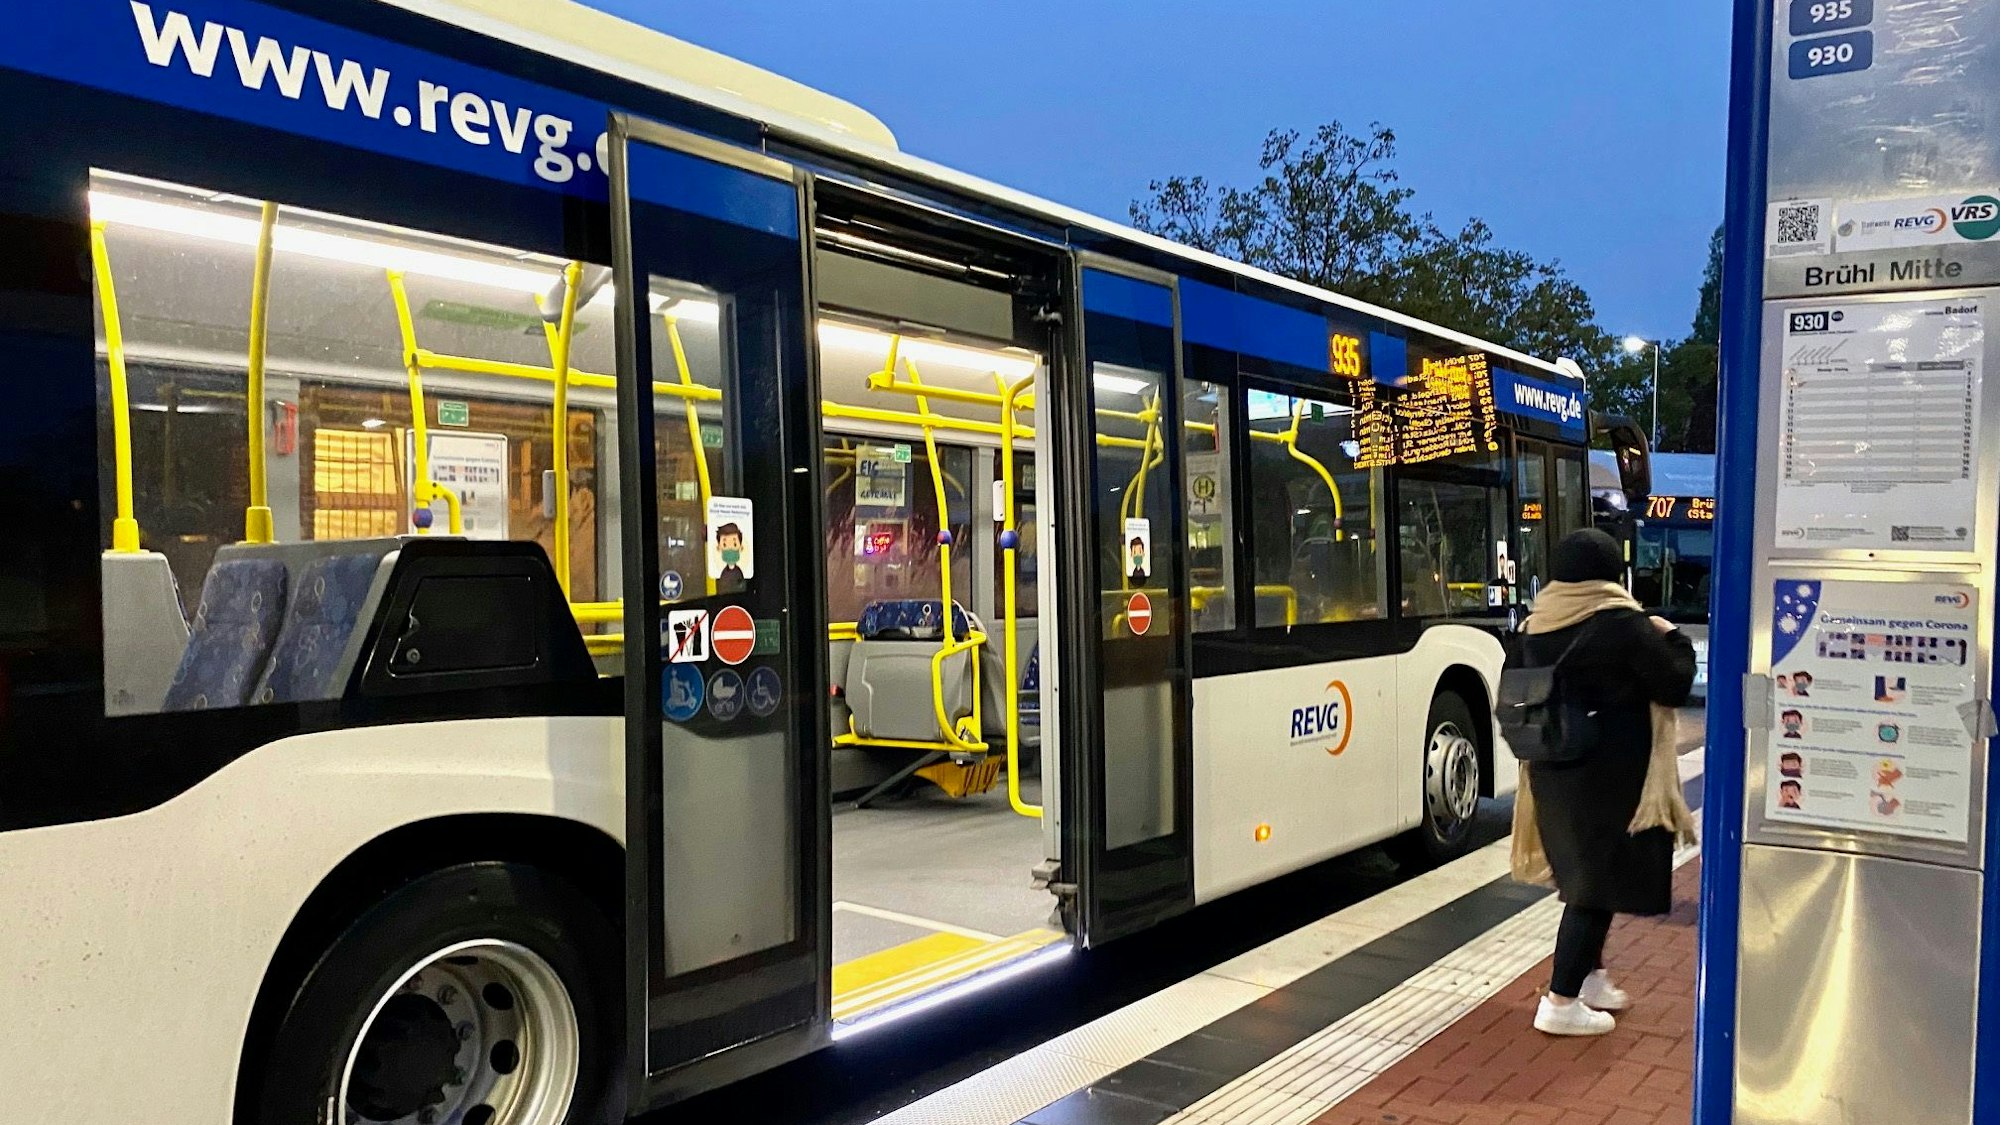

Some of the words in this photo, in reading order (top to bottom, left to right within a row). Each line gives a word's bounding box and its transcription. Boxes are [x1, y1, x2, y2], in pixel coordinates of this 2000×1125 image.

[1810, 0, 1852, 23] 935
[1808, 43, 1853, 67] 930
[1894, 215, 1936, 229] REVG
[1951, 204, 1993, 220] VRS
[1806, 263, 1875, 286] Brühl
[1890, 258, 1962, 281] Mitte
[1794, 314, 1824, 330] 930
[1332, 334, 1360, 376] 935
[1514, 382, 1581, 422] www.revg.de
[1647, 496, 1676, 518] 707
[1888, 619, 1923, 629] gegen
[1926, 620, 1969, 631] Corona
[1291, 702, 1338, 738] REVG
